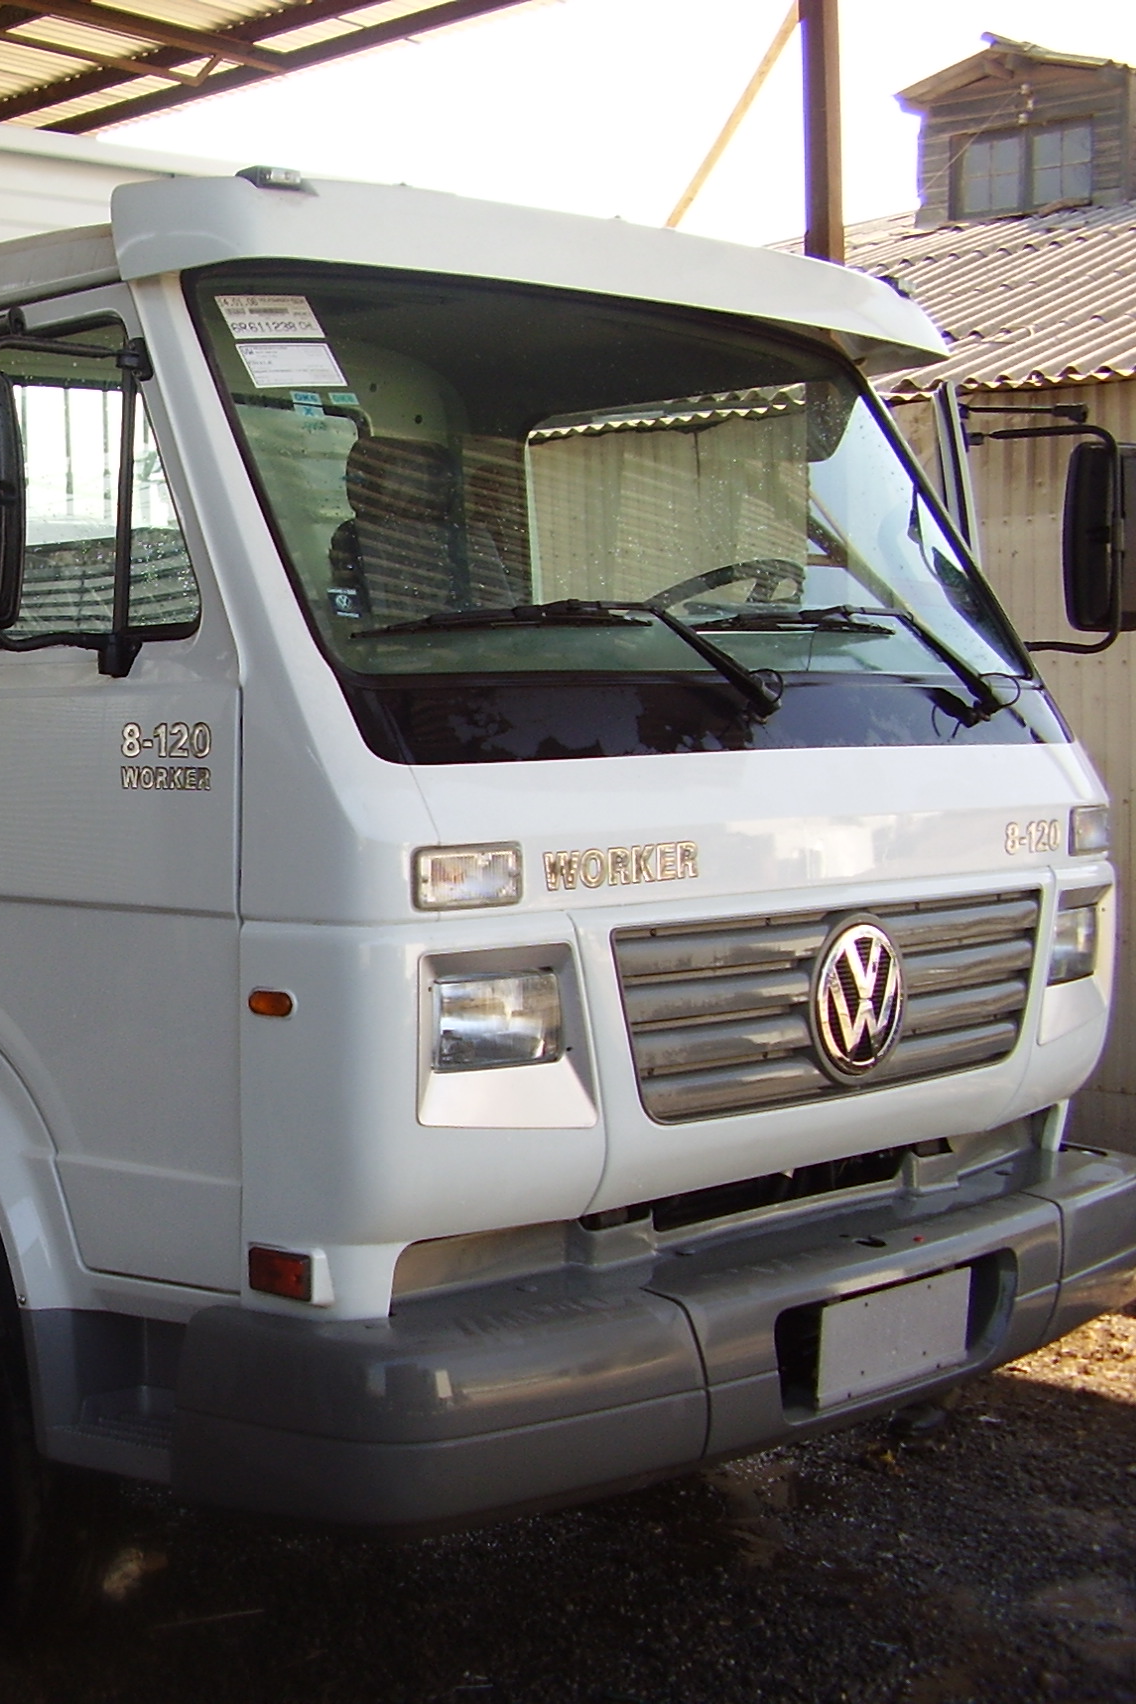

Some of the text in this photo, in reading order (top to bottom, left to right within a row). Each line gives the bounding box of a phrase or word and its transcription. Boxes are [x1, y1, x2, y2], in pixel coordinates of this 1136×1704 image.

[121, 721, 212, 759] 8-120
[120, 765, 211, 791] WORKER
[1004, 818, 1061, 855] 8-120
[543, 840, 698, 892] WORKER
